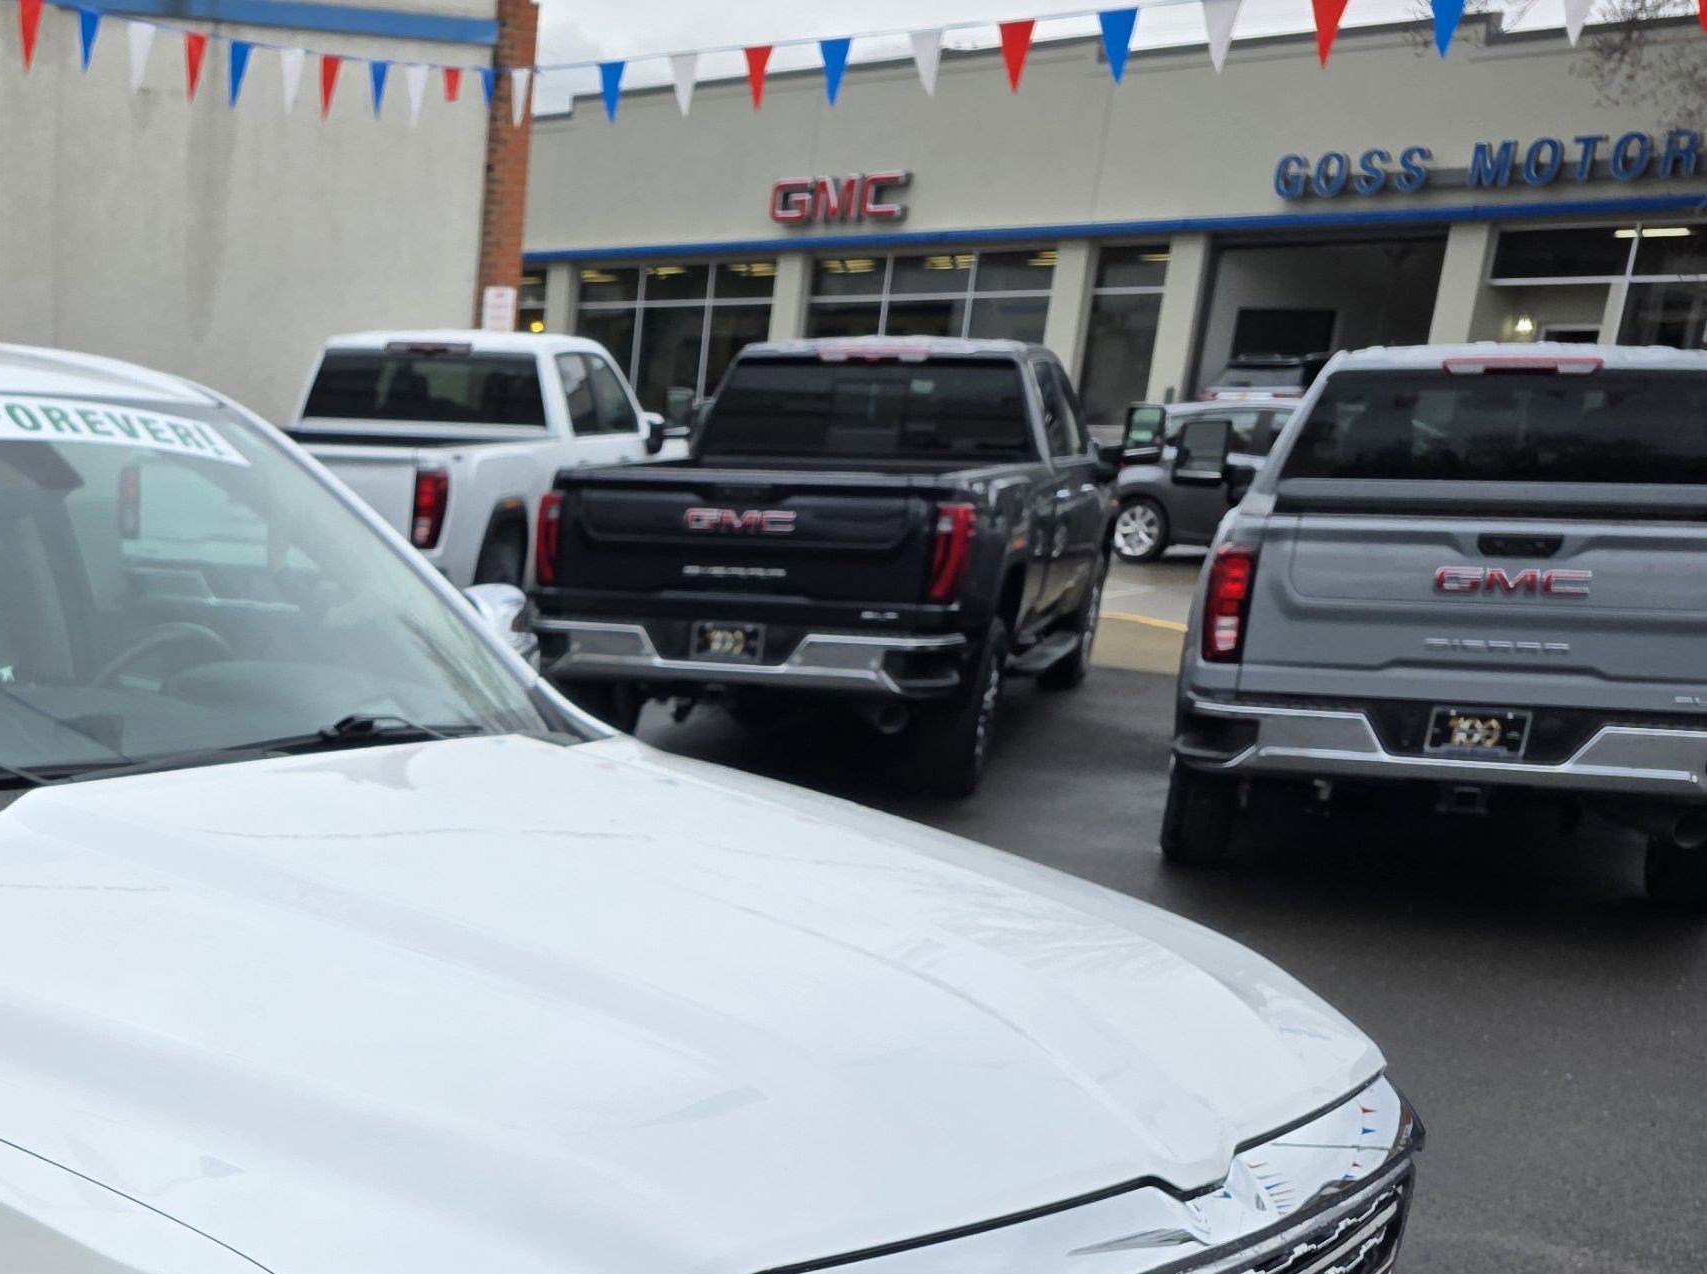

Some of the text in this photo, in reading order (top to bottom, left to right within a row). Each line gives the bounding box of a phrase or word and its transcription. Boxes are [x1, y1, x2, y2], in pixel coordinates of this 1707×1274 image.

[1272, 145, 1431, 199] GOSS
[770, 169, 909, 224] GMC
[683, 507, 797, 532] GMC
[1434, 566, 1592, 595] GMC
